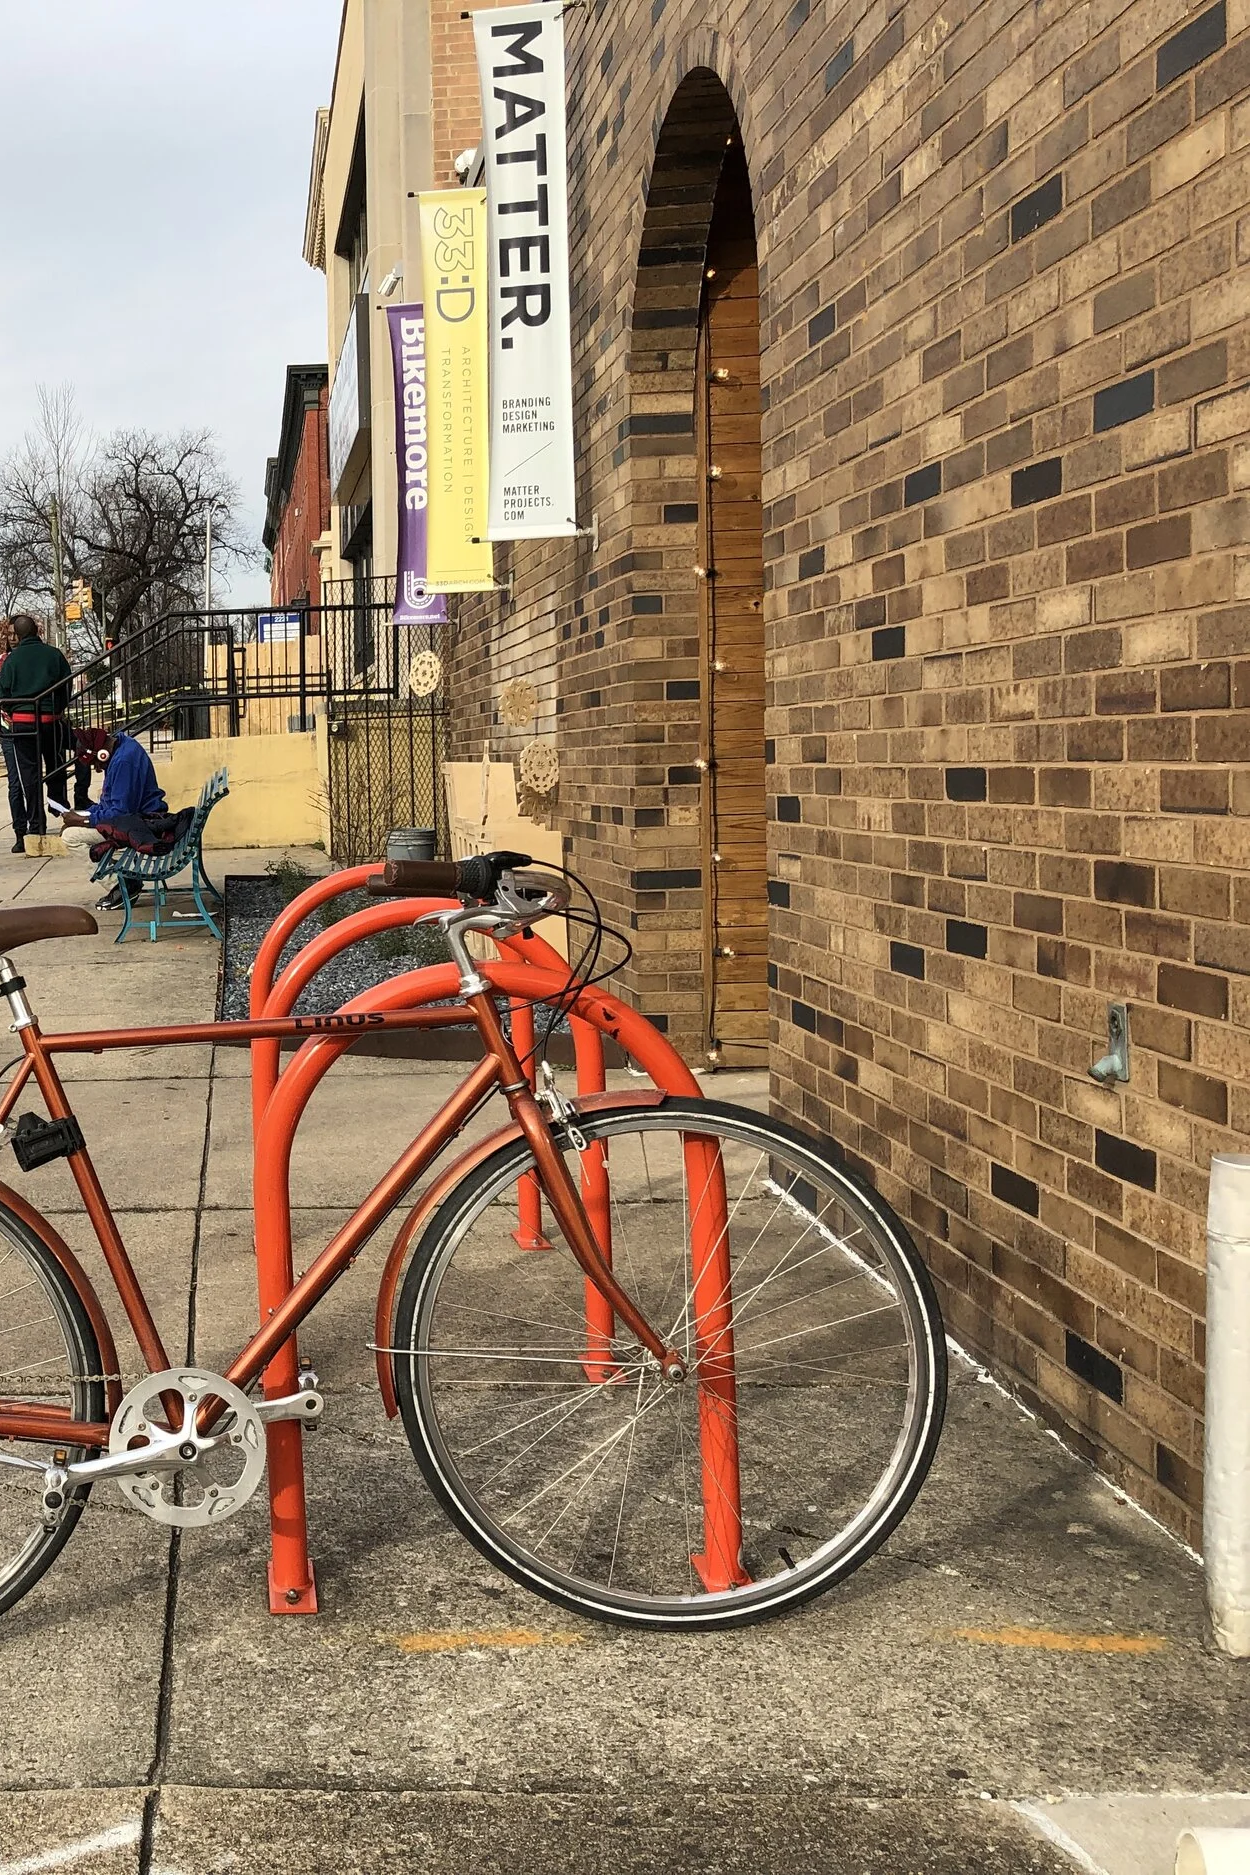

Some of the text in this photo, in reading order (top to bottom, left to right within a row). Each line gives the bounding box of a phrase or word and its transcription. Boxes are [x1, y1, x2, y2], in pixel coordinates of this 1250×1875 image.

[491, 20, 551, 350] MATTER.
[502, 396, 551, 410] BRANDING
[400, 317, 428, 511] Bikemore
[502, 409, 538, 422] DESIGN
[441, 348, 453, 494] TRANSFORMATION
[502, 421, 555, 434] MARKETING
[462, 346, 474, 543] ARCHITECTURE DESIGN
[503, 485, 540, 497] MATTER
[503, 496, 554, 509] PROJECTS.
[504, 510, 525, 521] COM
